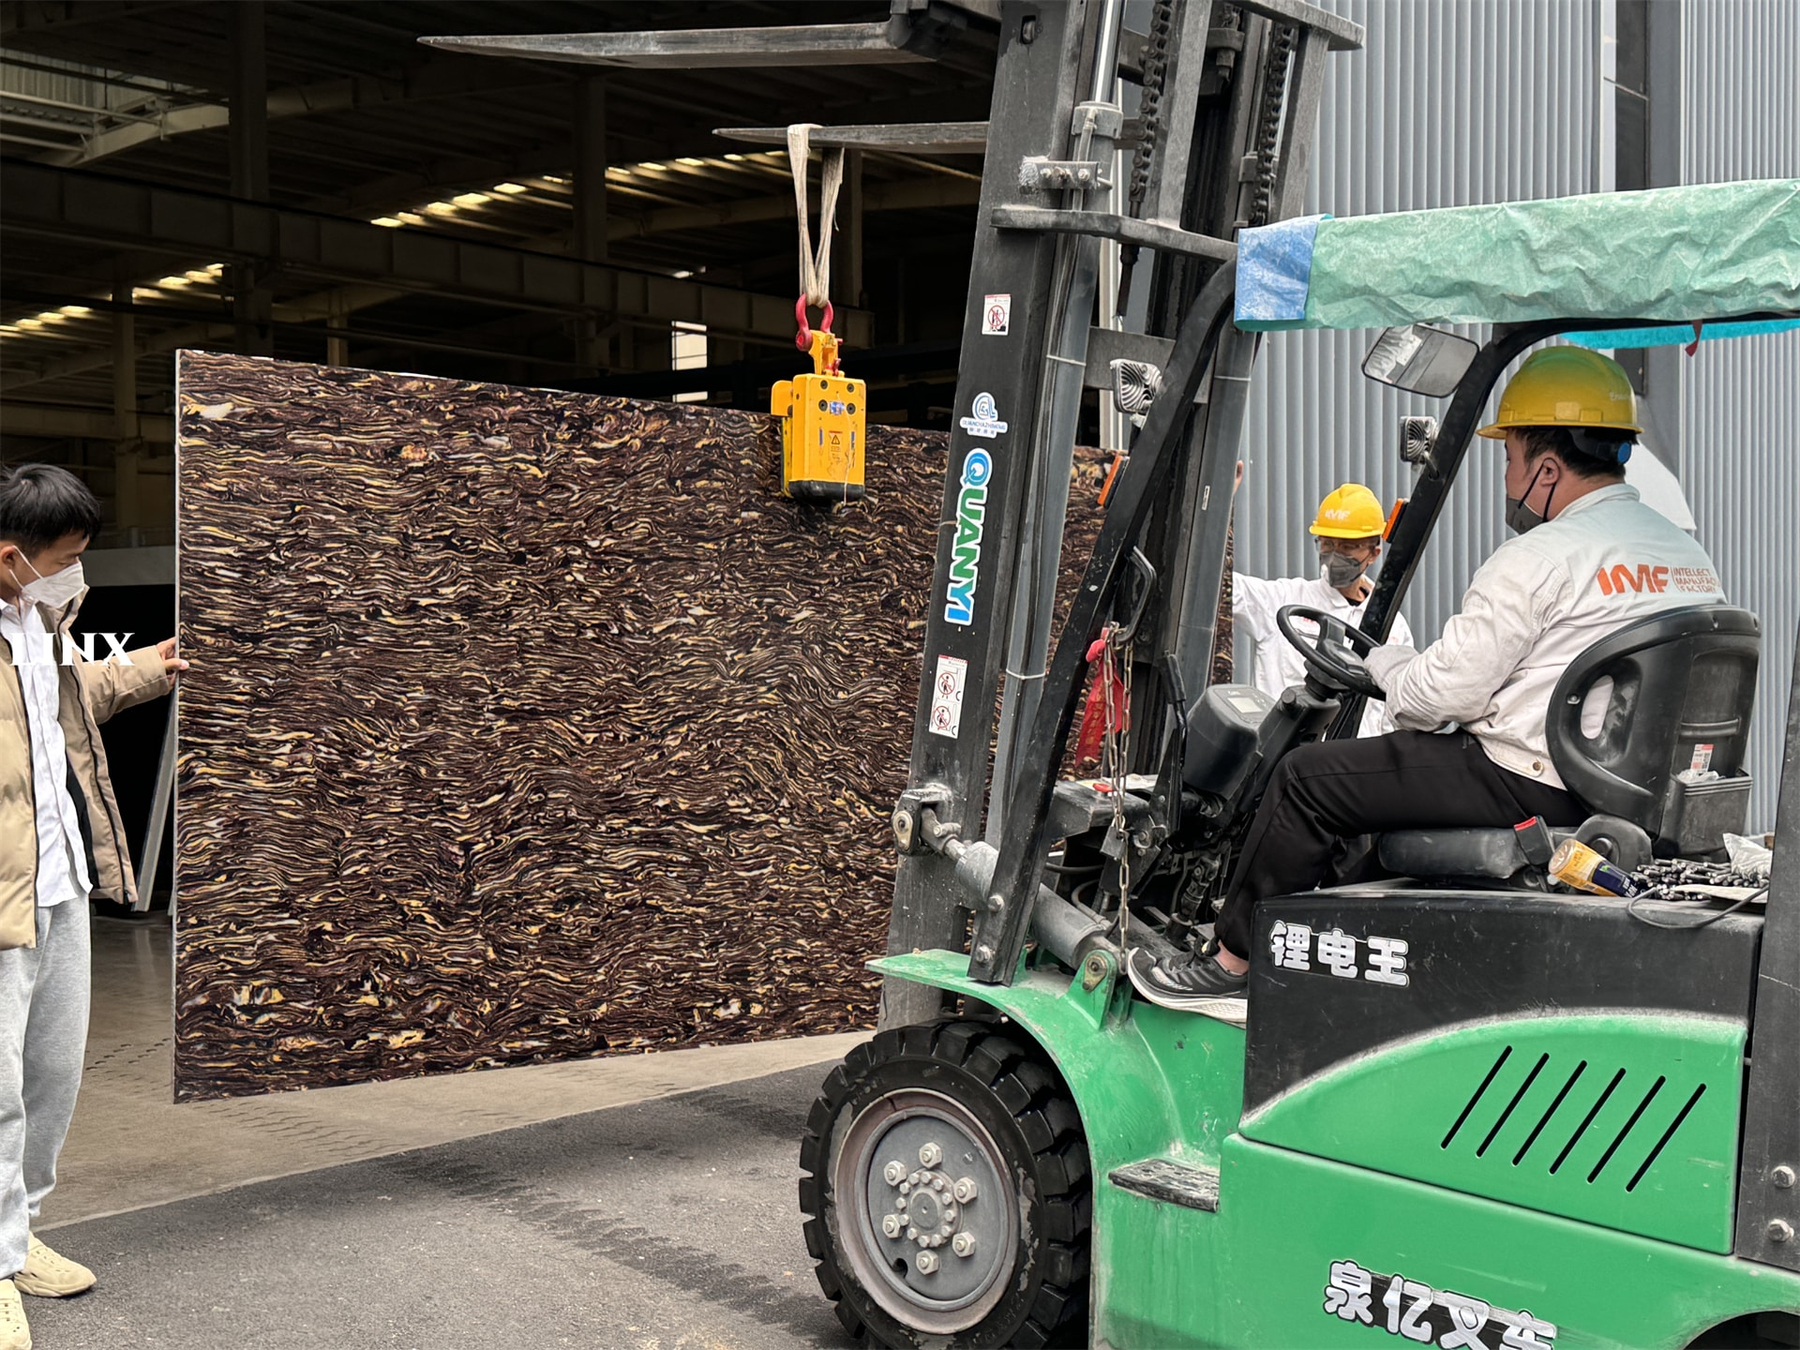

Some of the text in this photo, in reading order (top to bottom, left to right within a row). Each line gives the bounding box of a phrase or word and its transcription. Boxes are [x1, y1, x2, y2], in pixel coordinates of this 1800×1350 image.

[947, 452, 989, 622] QUANYI
[1597, 564, 1669, 596] IMF
[1673, 567, 1710, 577] INTELLECT
[1675, 576, 1719, 587] MANUFAC
[1270, 921, 1409, 986] 锂电王
[1323, 1261, 1556, 1350] 泉亿叉车
